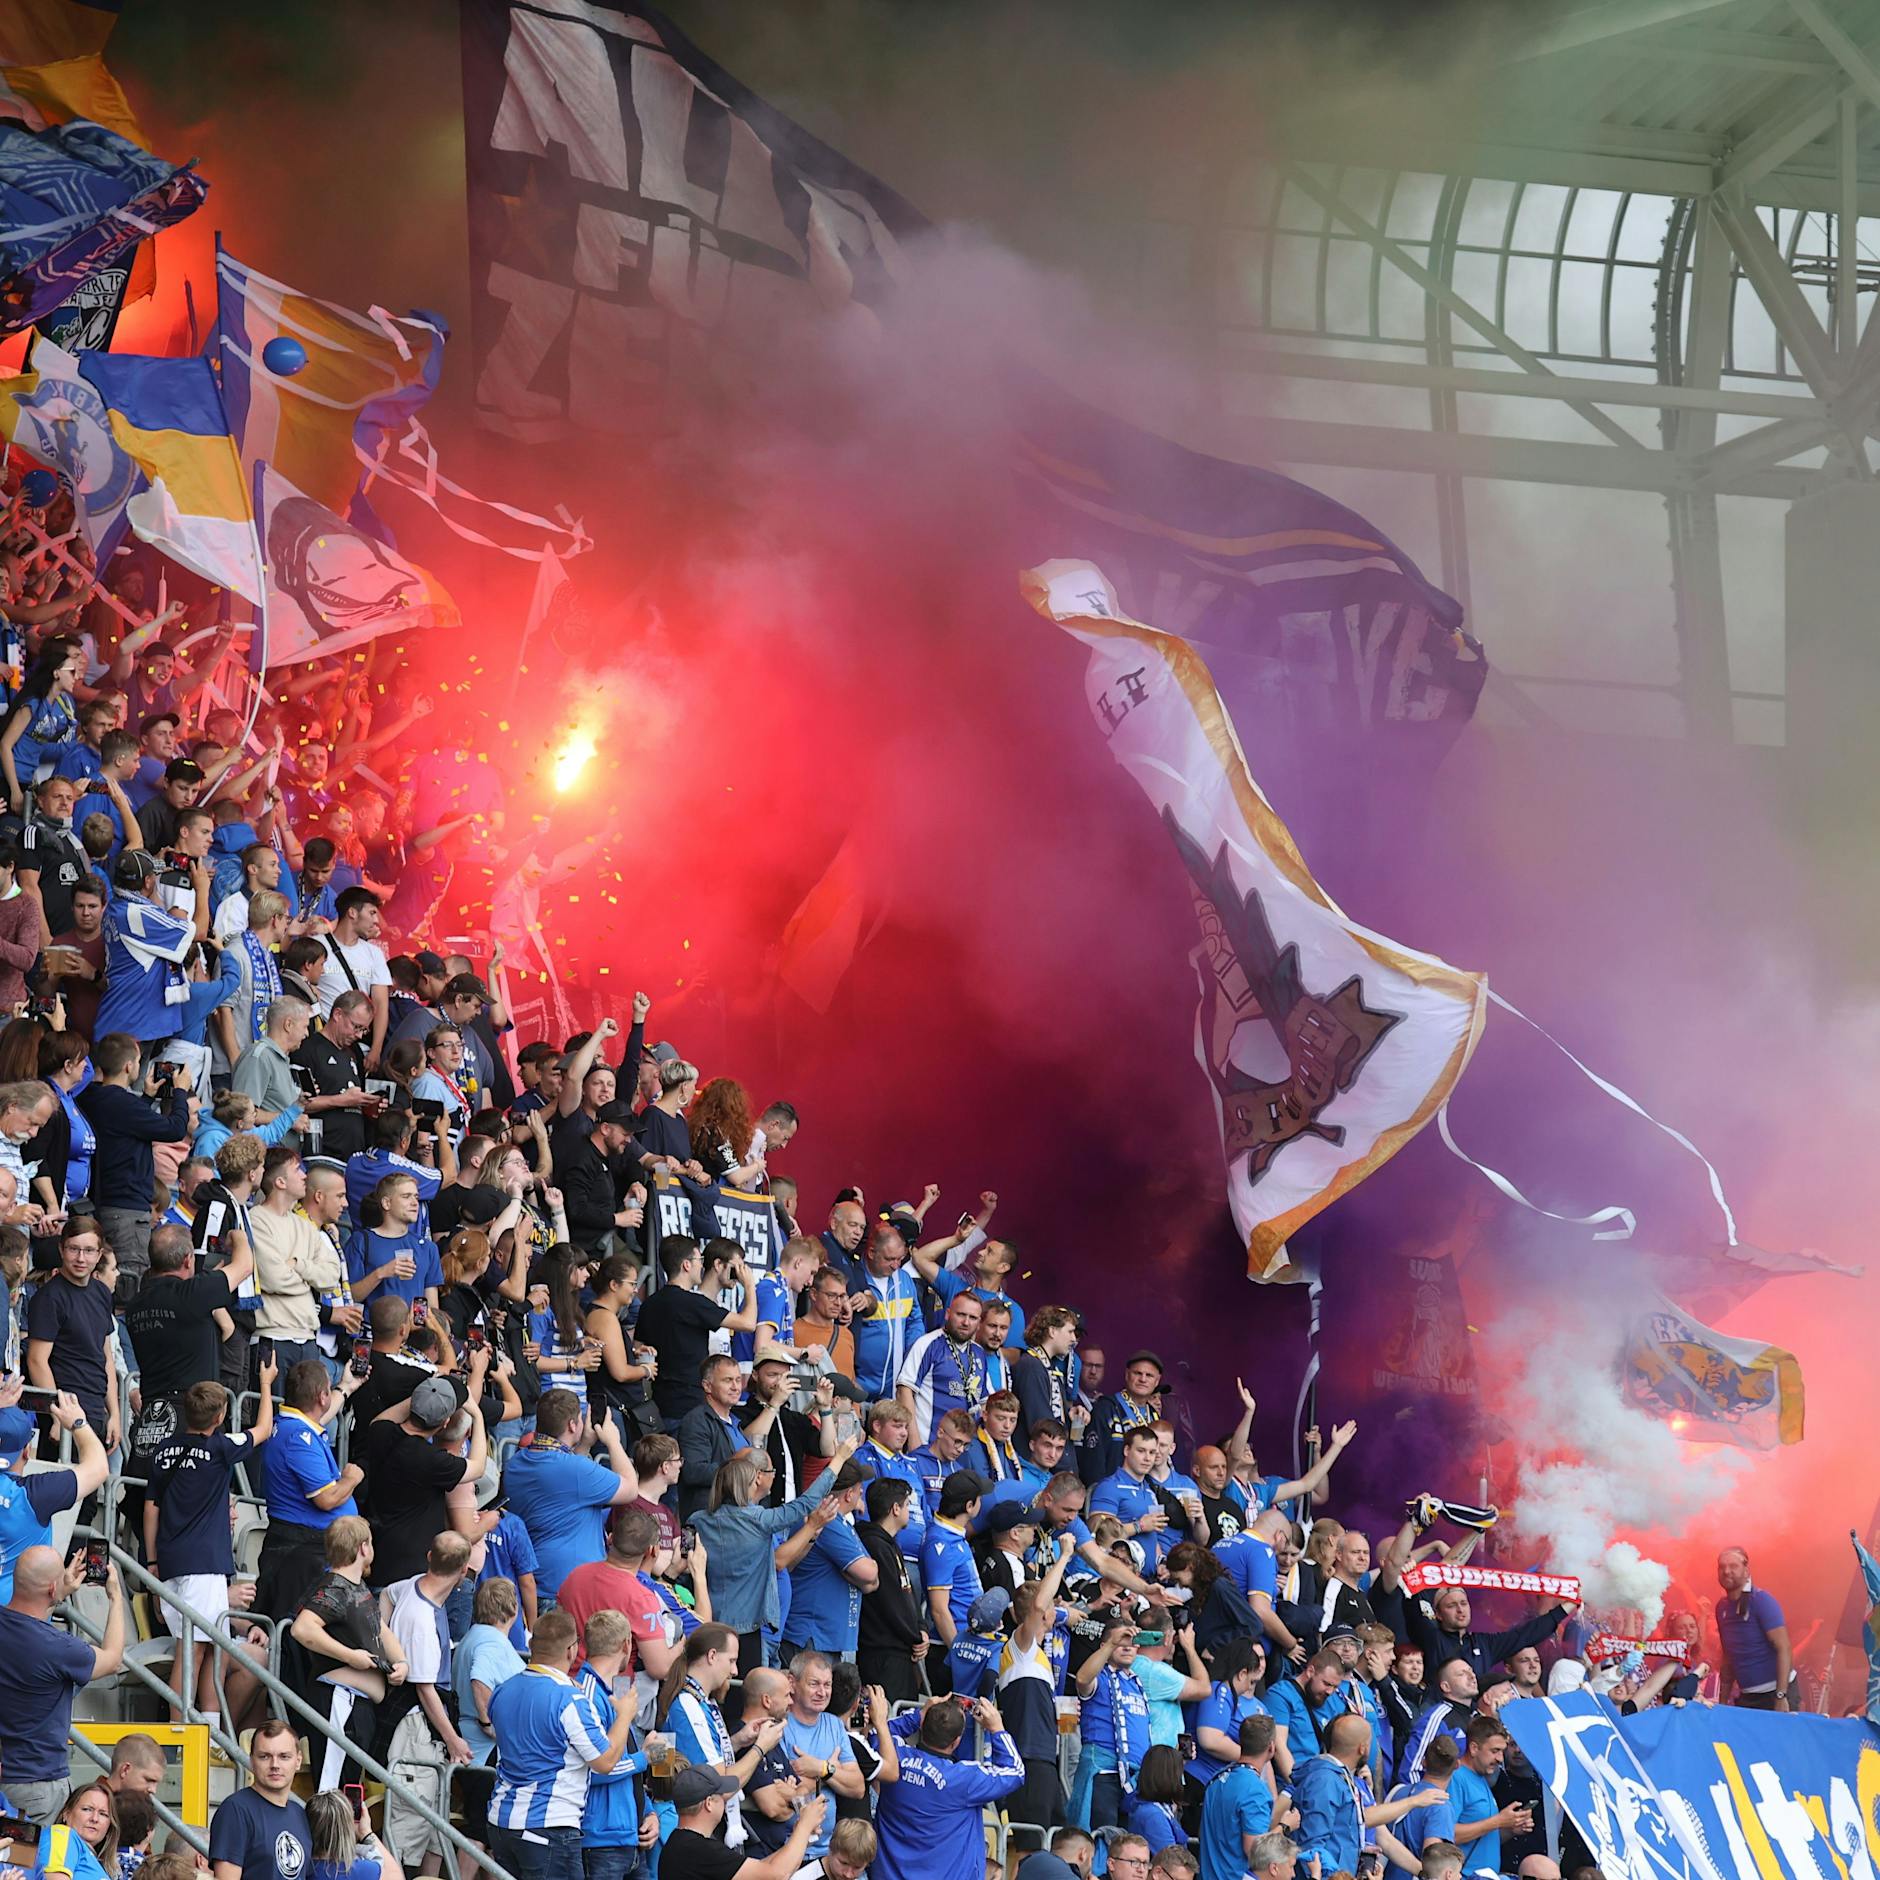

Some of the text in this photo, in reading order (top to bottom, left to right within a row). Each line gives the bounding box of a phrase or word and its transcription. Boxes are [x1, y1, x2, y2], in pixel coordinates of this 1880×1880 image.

[1420, 1563, 1580, 1601] SÜDKURVE
[957, 1649, 982, 1662] JENA
[900, 1757, 947, 1791] CARL ZEISS
[902, 1770, 926, 1788] JENA
